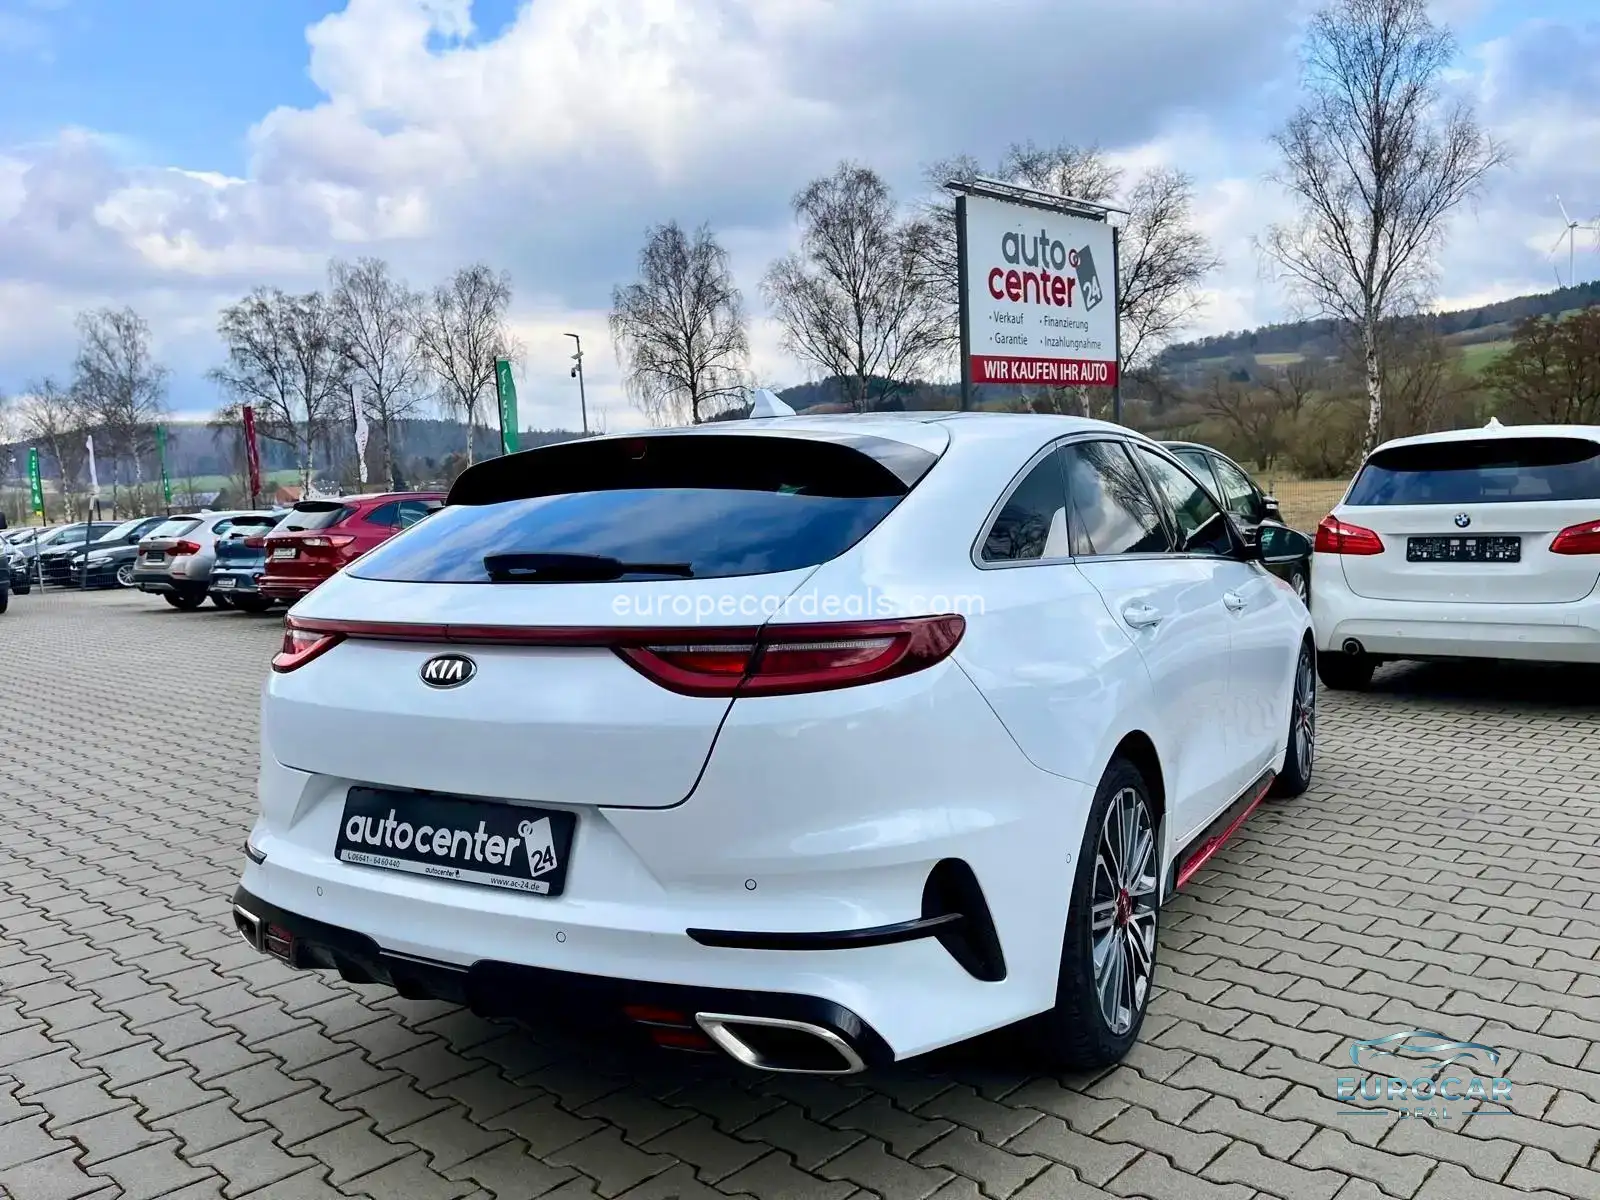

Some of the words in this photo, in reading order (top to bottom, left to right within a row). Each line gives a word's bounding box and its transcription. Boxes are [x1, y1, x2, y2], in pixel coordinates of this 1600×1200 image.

[1002, 229, 1066, 270] auto
[988, 268, 1075, 307] center
[1083, 276, 1100, 302] 24
[994, 311, 1024, 324] Verkauf
[1044, 316, 1088, 332] Finanzierung
[995, 333, 1028, 345] Garantie
[1045, 338, 1101, 351] Inzahlungnahme
[984, 361, 1008, 379] WIR
[1011, 362, 1058, 380] KAUFEN
[1060, 365, 1078, 381] IHR
[1081, 363, 1107, 381] AUTO
[425, 660, 463, 679] KIA
[346, 809, 520, 866] autocenter
[530, 845, 554, 873] 24
[425, 867, 455, 877] autocenter
[491, 877, 540, 891] www.ac-24.de
